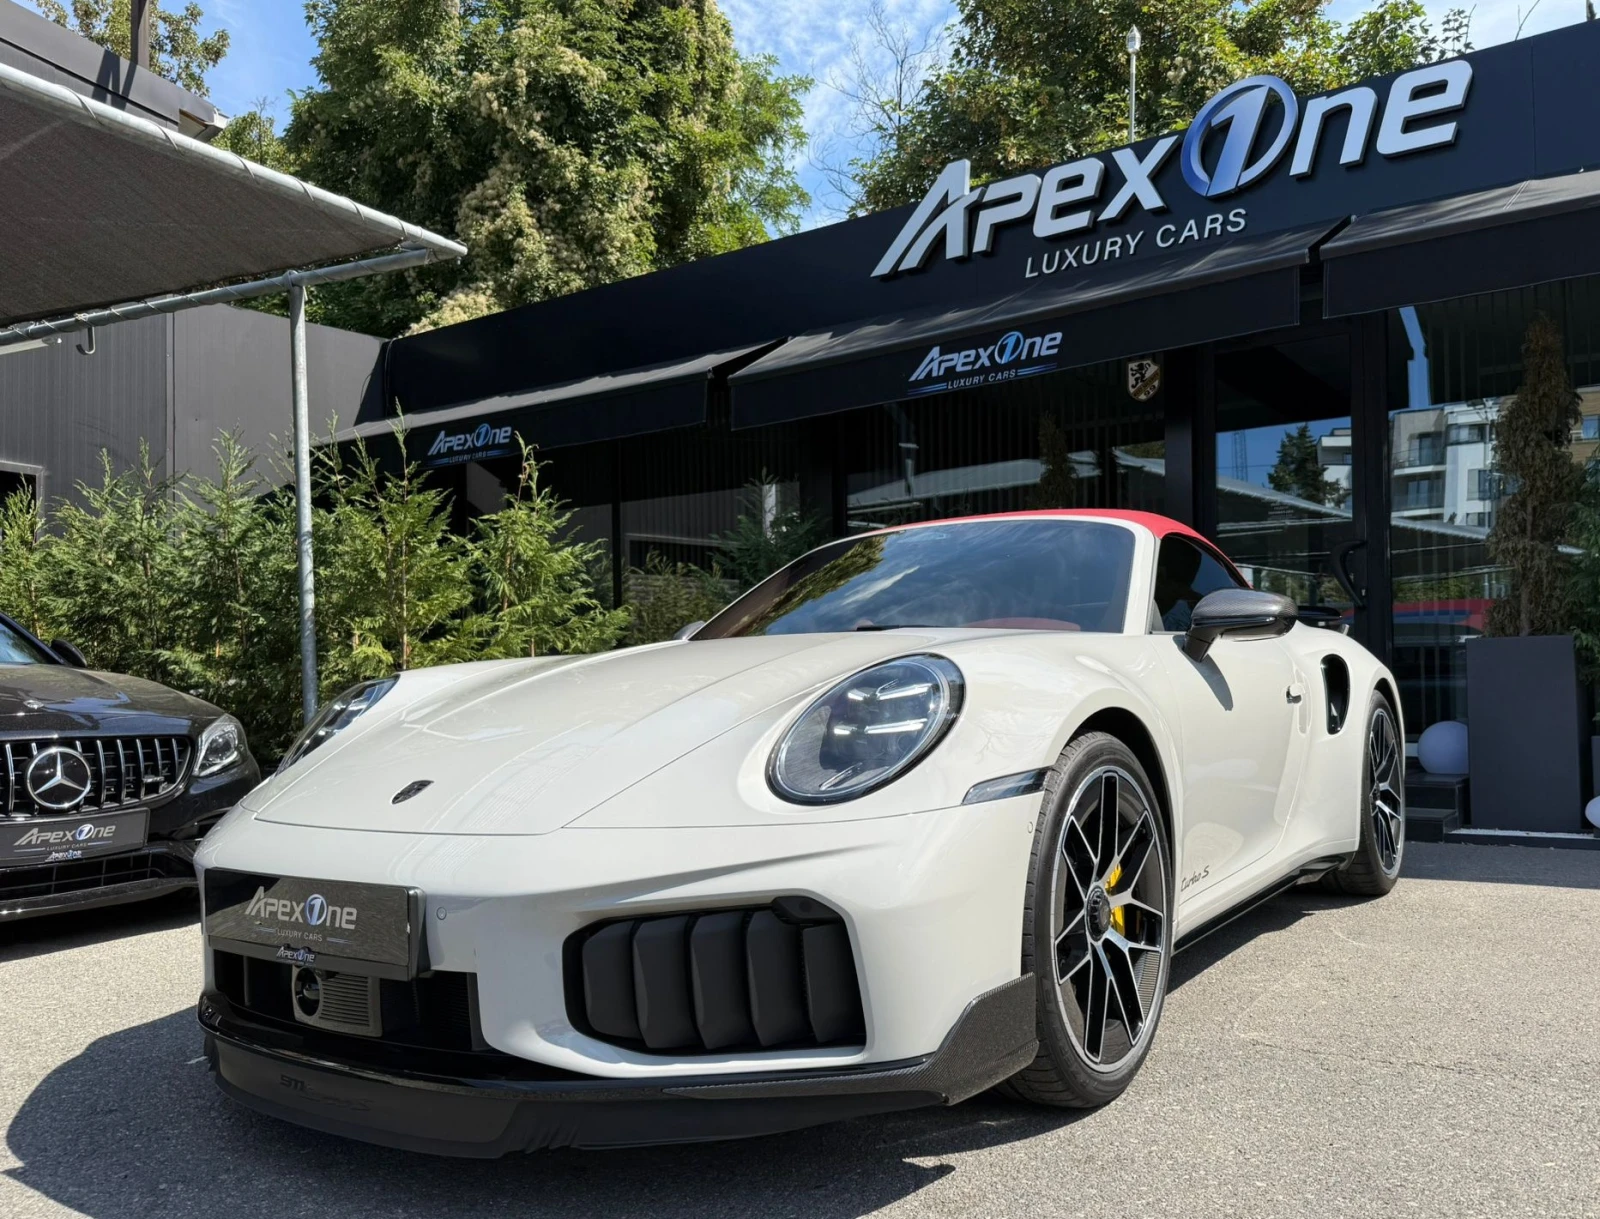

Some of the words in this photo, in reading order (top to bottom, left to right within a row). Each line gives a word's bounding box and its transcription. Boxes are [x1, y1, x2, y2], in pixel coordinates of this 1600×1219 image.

[1024, 230, 1144, 278] LUXURY
[1156, 208, 1247, 248] CARS
[948, 375, 985, 389] LUXURY
[988, 369, 1016, 382] CARS
[277, 928, 302, 938] LUXURY
[303, 932, 323, 942] CARS
